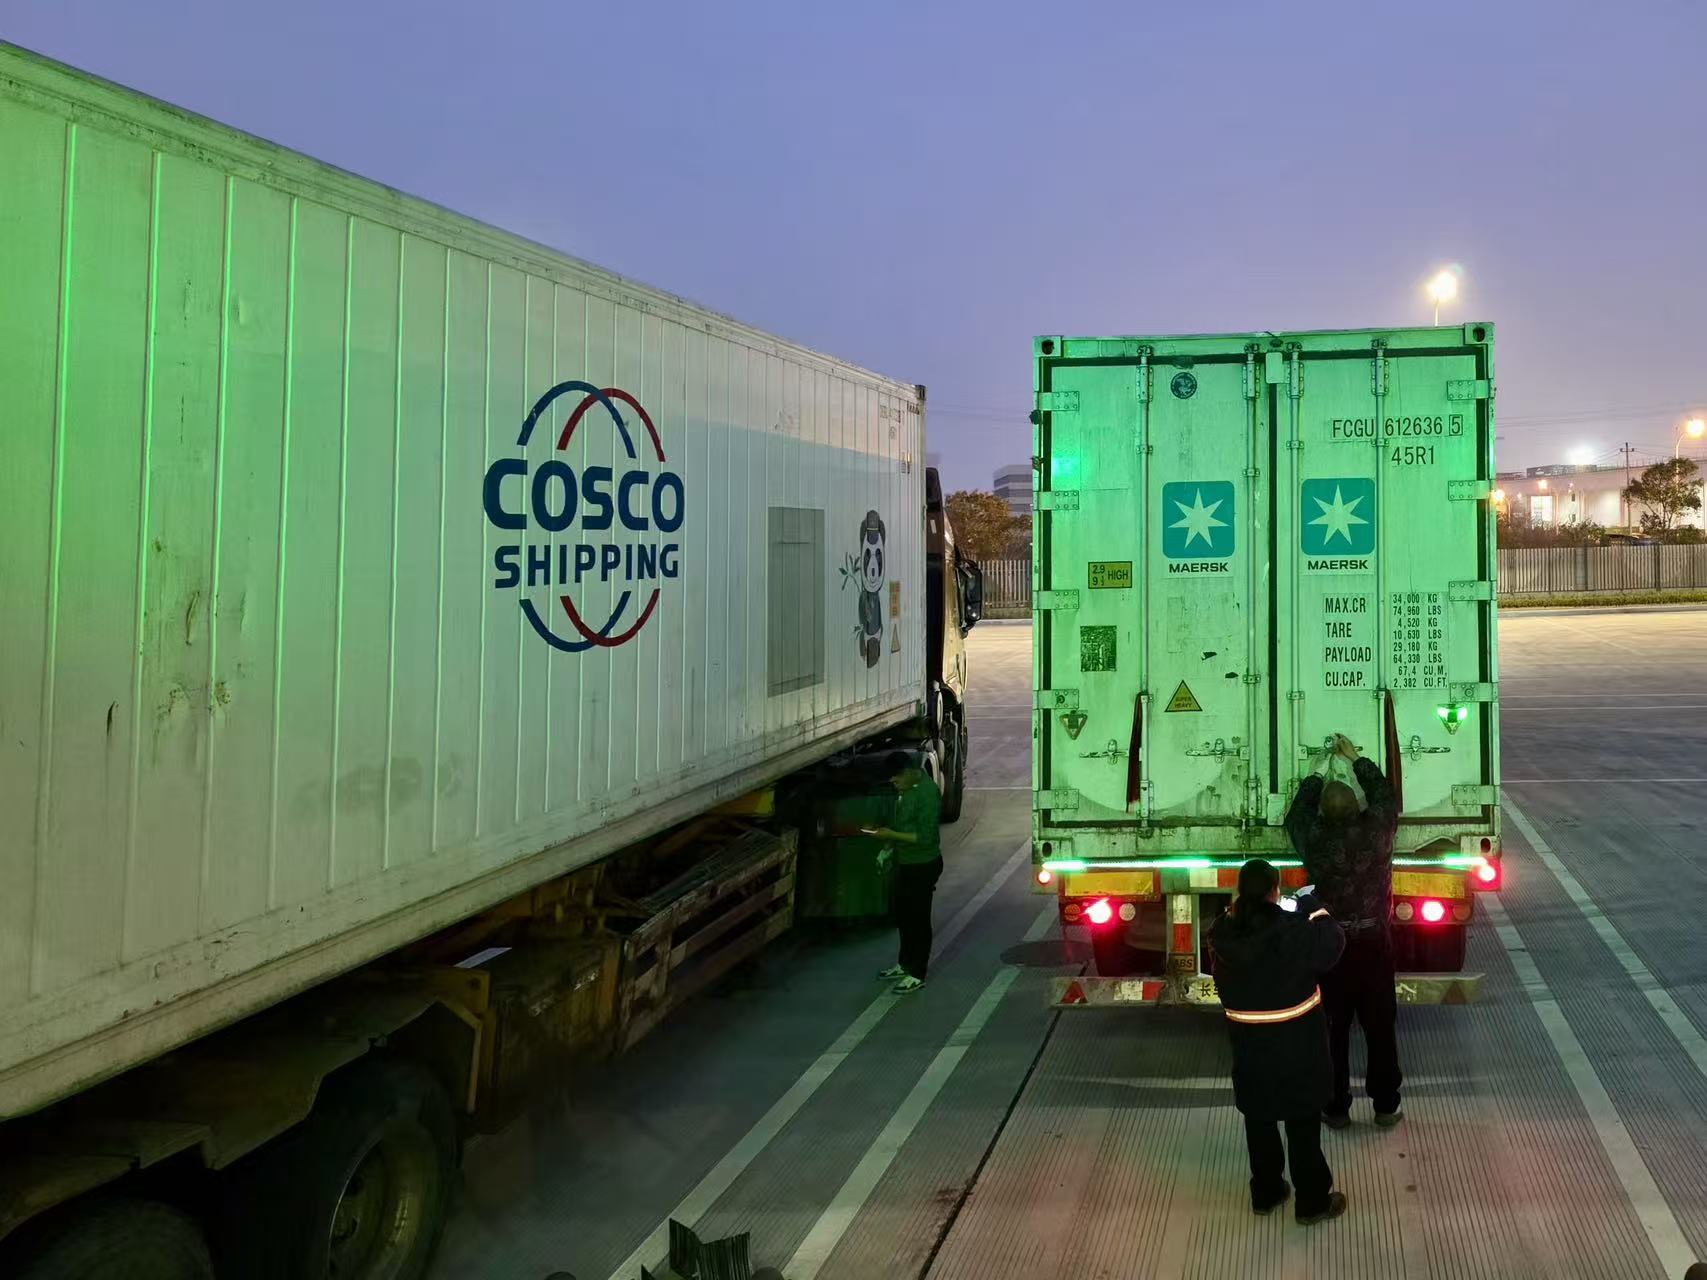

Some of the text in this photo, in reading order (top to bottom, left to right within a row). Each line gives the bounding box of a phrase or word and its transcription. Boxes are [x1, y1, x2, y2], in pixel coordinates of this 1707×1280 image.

[1332, 415, 1462, 438] FCGU 612636 5
[1391, 445, 1435, 465] 45R1
[482, 458, 685, 532] COSCO
[494, 543, 679, 588] SHIPPING
[1168, 562, 1229, 573] MAERSK
[1307, 559, 1369, 570] MAERSK
[1107, 569, 1129, 580] HIGH
[1427, 593, 1438, 603] KG
[1325, 597, 1366, 613] MAX.CR
[1427, 605, 1442, 615] LBS
[1427, 617, 1438, 627] KG
[1325, 622, 1352, 638] TARE
[1427, 629, 1442, 639] LBS
[1428, 641, 1438, 651] KG
[1325, 647, 1372, 662] PAYLOAD
[1428, 653, 1443, 663] LBS
[1325, 671, 1366, 687] CU.CAP.
